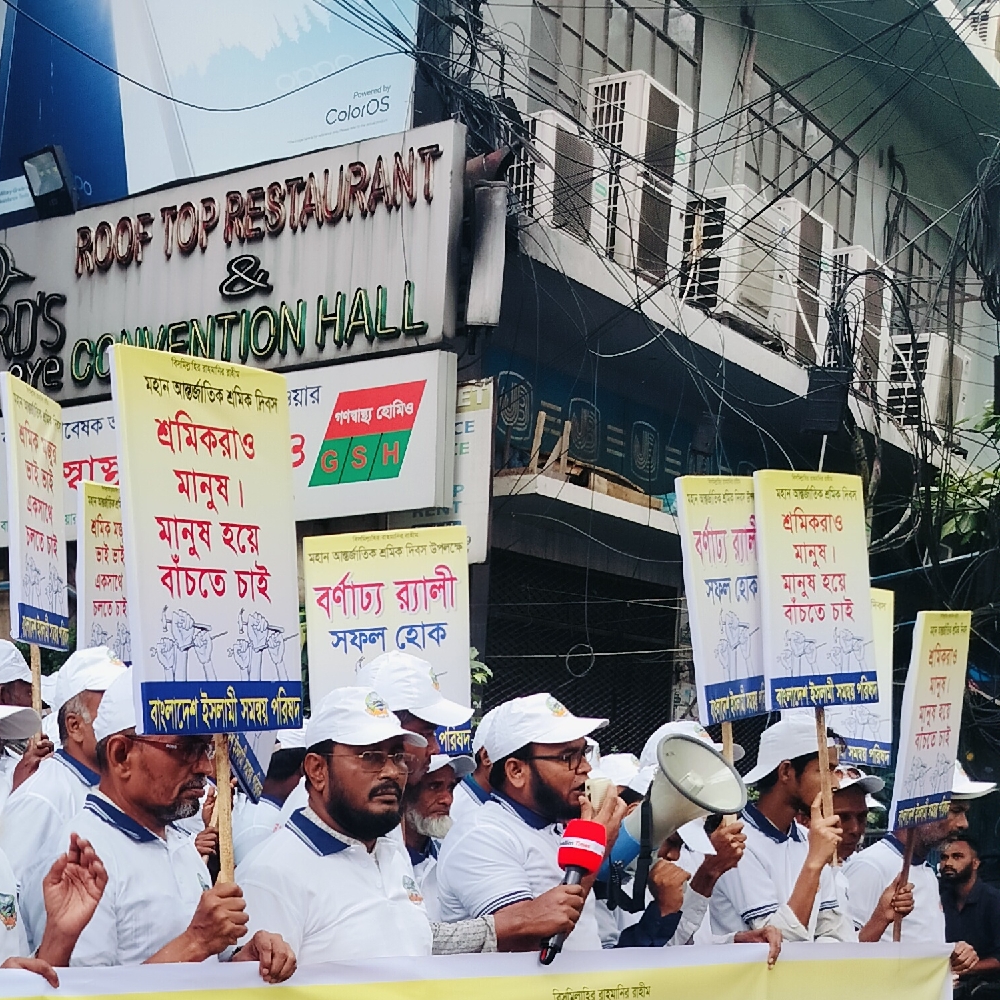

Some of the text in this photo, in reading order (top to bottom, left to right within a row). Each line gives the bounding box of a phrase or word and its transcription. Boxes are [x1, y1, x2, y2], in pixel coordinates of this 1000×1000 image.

[353, 84, 392, 99] Powered by
[325, 95, 390, 125] ColorOS
[75, 143, 444, 276] ROOF TOP RESTAURANT
[219, 254, 273, 298] &
[317, 280, 429, 350] HALL
[144, 375, 170, 398] মহান
[172, 378, 224, 405] আন্তর্জাতিক
[226, 384, 253, 411] শ্রমিক
[255, 388, 279, 414] দিবস
[376, 398, 415, 421] হোমিও
[154, 409, 256, 461] শ্রমিকরাও
[25, 458, 55, 497] ভাই ভাই
[90, 512, 111, 539] শ্রমিক
[781, 506, 844, 534] শ্রমিকরাও
[46, 532, 59, 561] চাই
[154, 515, 261, 560] মানুষ হয়ে
[693, 516, 728, 565] বর্ণাঢ্য
[95, 541, 126, 566] ভাই ভাই
[308, 541, 464, 565] মহান আন্তর্জাতিক শ্রমিক দিবস উপলক্ষে
[157, 553, 272, 604] বাঁচতে চাই
[312, 564, 458, 620] বর্ণাঢ্য র‍্যালী
[704, 575, 758, 605] সফল হোক
[781, 573, 847, 600] মানুষ হয়ে
[92, 594, 128, 619] চলতে চাই
[782, 596, 856, 626] বাঁচতে চাই
[328, 621, 449, 655] সফল হোক
[928, 642, 958, 670] শ্রমিকরাও
[857, 674, 879, 702] পরিষদ
[149, 685, 302, 732] বাংলাদেশ ইসলামী সমন্বয় পরিষদ
[919, 704, 938, 728] মানুষ
[939, 727, 952, 749] চাই
[869, 743, 891, 766] পরিষদ
